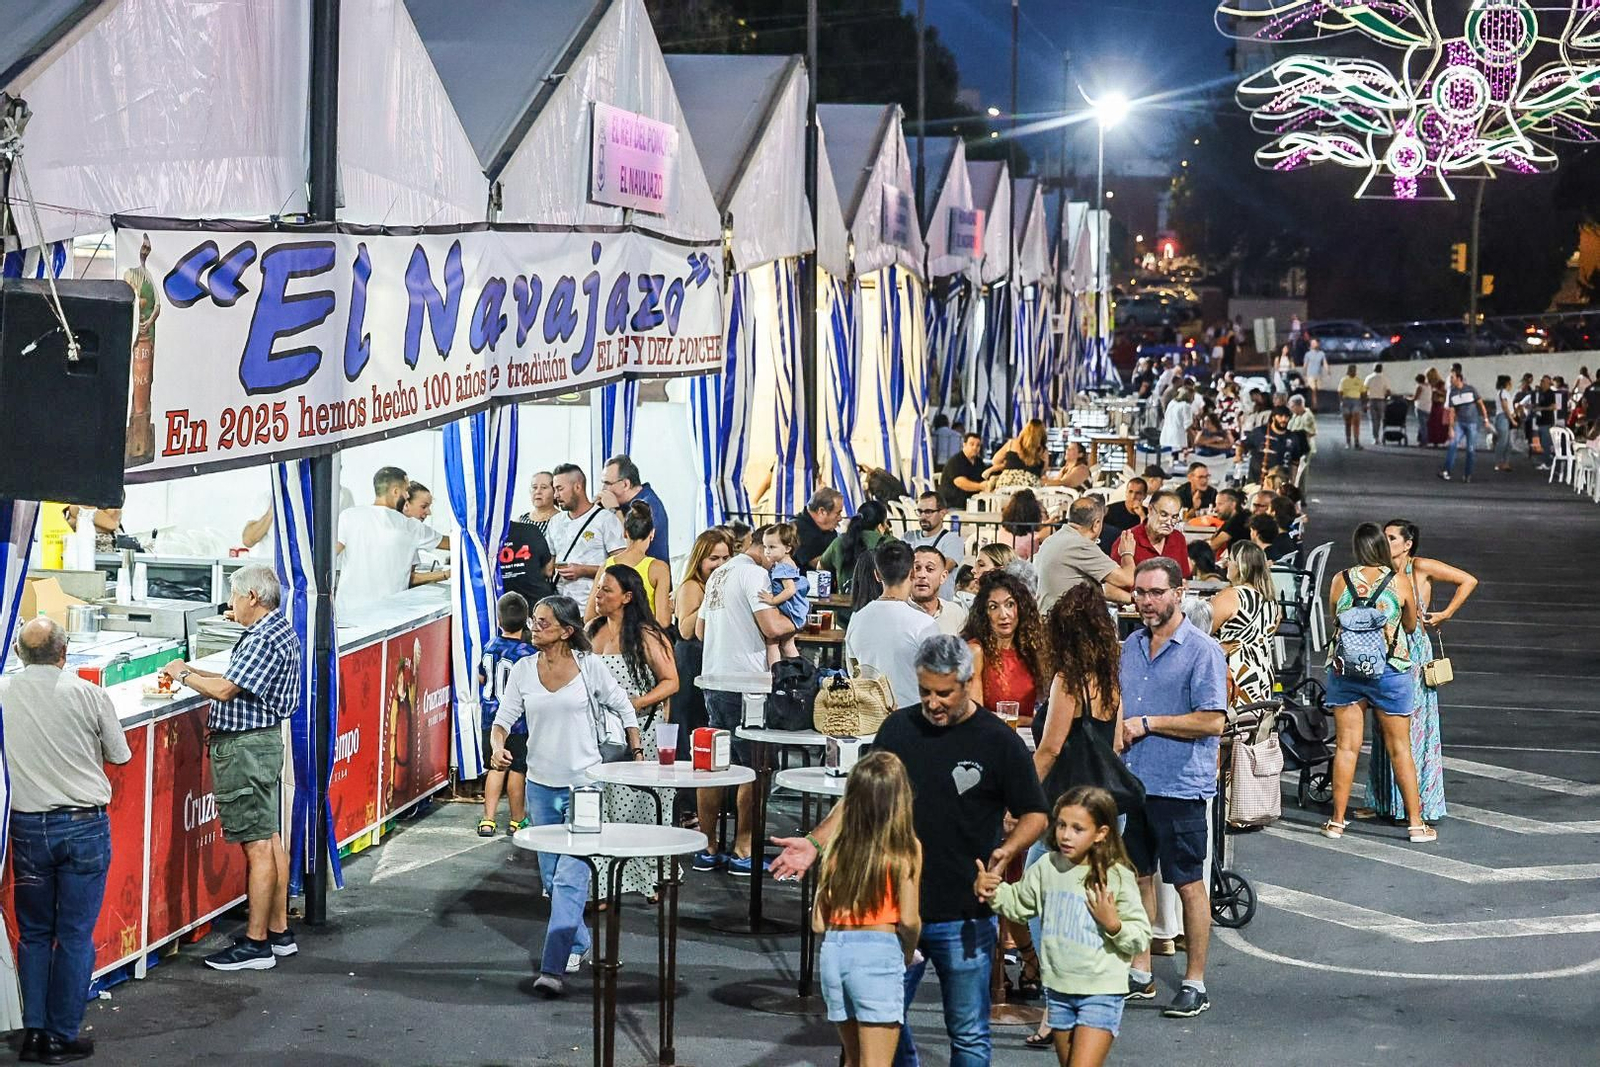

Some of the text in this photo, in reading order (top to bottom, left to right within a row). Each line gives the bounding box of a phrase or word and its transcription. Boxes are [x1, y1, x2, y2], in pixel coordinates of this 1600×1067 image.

[620, 166, 663, 199] EL NAVAJAZO
[597, 340, 614, 372] EL
[648, 336, 674, 365] DEL
[676, 335, 722, 365] PONCHE
[162, 409, 208, 457] En
[218, 401, 289, 450] 2025
[298, 395, 367, 438] hemos
[372, 379, 418, 423] hecho
[423, 373, 451, 411] 100
[456, 362, 486, 403] años
[508, 348, 568, 389] tradición
[482, 653, 515, 703] 10
